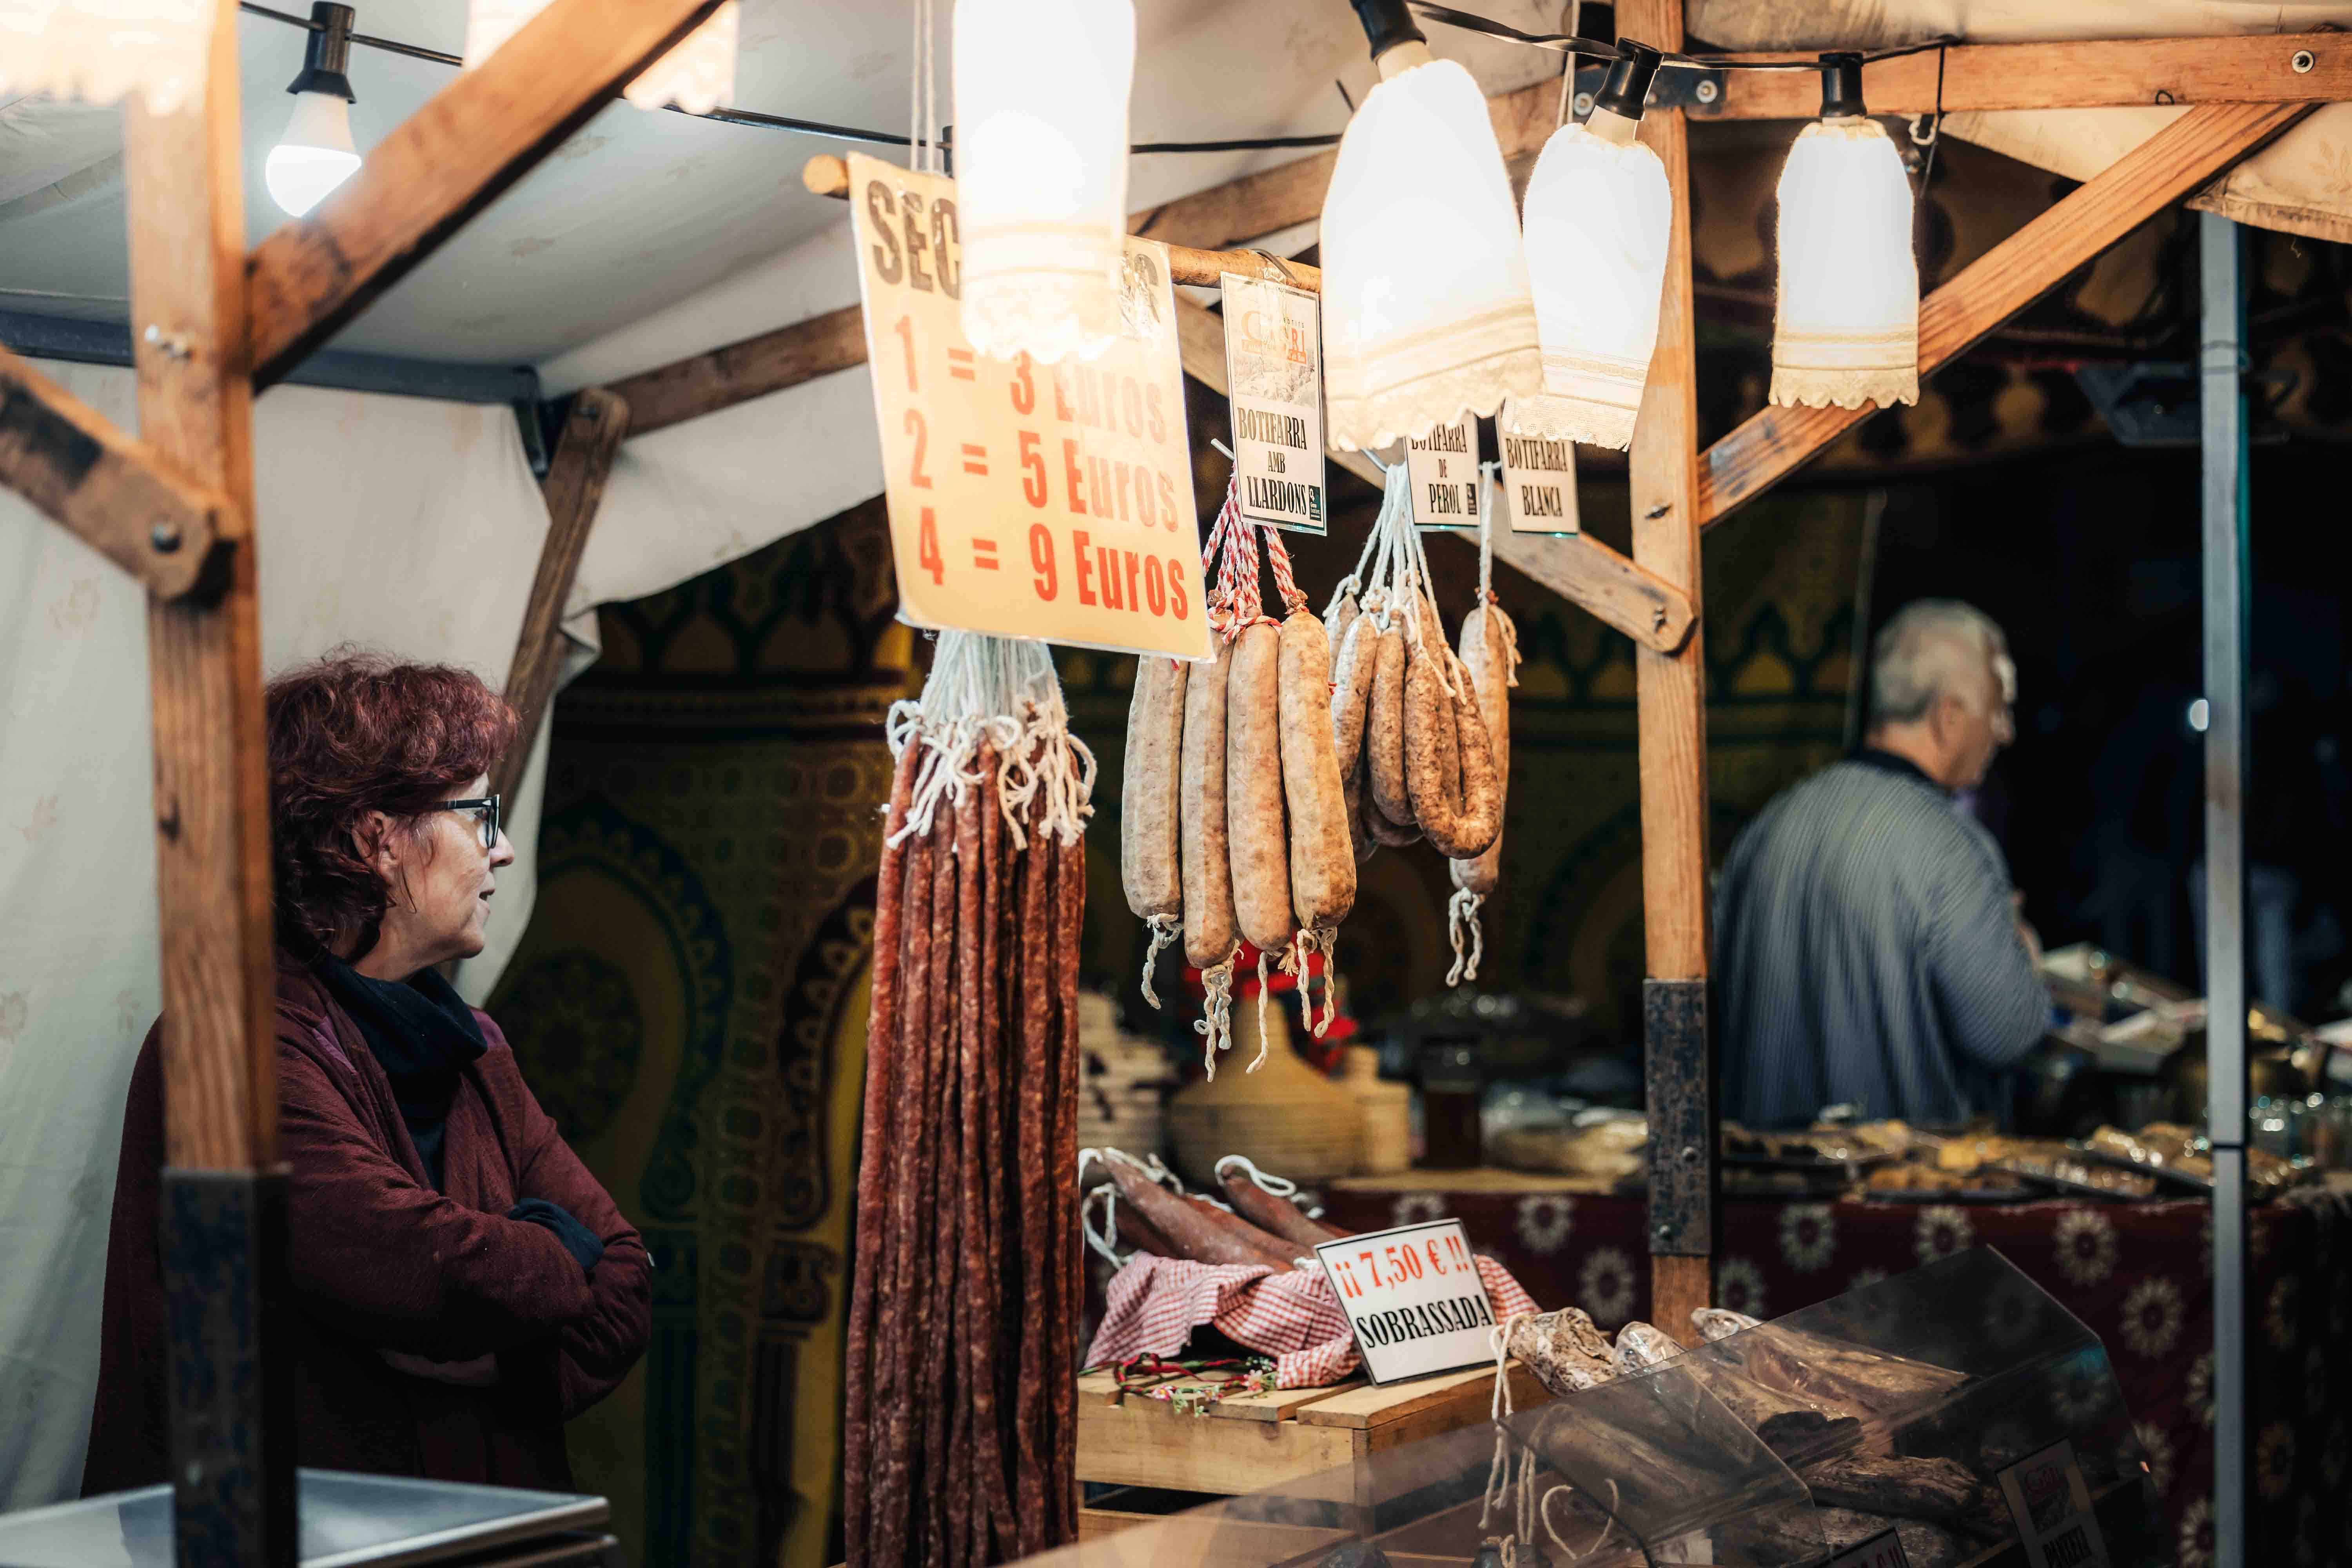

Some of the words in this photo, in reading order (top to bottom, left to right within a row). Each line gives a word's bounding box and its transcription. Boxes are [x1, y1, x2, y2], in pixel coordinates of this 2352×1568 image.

[894, 315, 918, 393] 1
[947, 347, 976, 383] =
[1010, 349, 1035, 415] 3
[1053, 363, 1167, 444] Euros
[1237, 407, 1307, 450] BOTIFARRA
[904, 408, 933, 491] 2
[961, 443, 989, 476] =
[1018, 430, 1048, 508] 5
[1062, 438, 1179, 532] Euros
[1268, 451, 1285, 473] AMB
[1439, 459, 1447, 478] DE
[1506, 438, 1568, 472] BOTIFARRA
[1247, 475, 1307, 515] LLARDONS
[1428, 483, 1461, 514] PEROL
[1522, 485, 1562, 517] BLANCA
[918, 507, 945, 586] 4
[972, 537, 1000, 571] =
[1029, 522, 1058, 603] 9
[1072, 530, 1189, 621] Euros
[1359, 1244, 1423, 1290] 7,50
[1426, 1239, 1447, 1275] €
[1445, 1235, 1469, 1272] !!
[1356, 1295, 1492, 1348] SOBRASSADA
